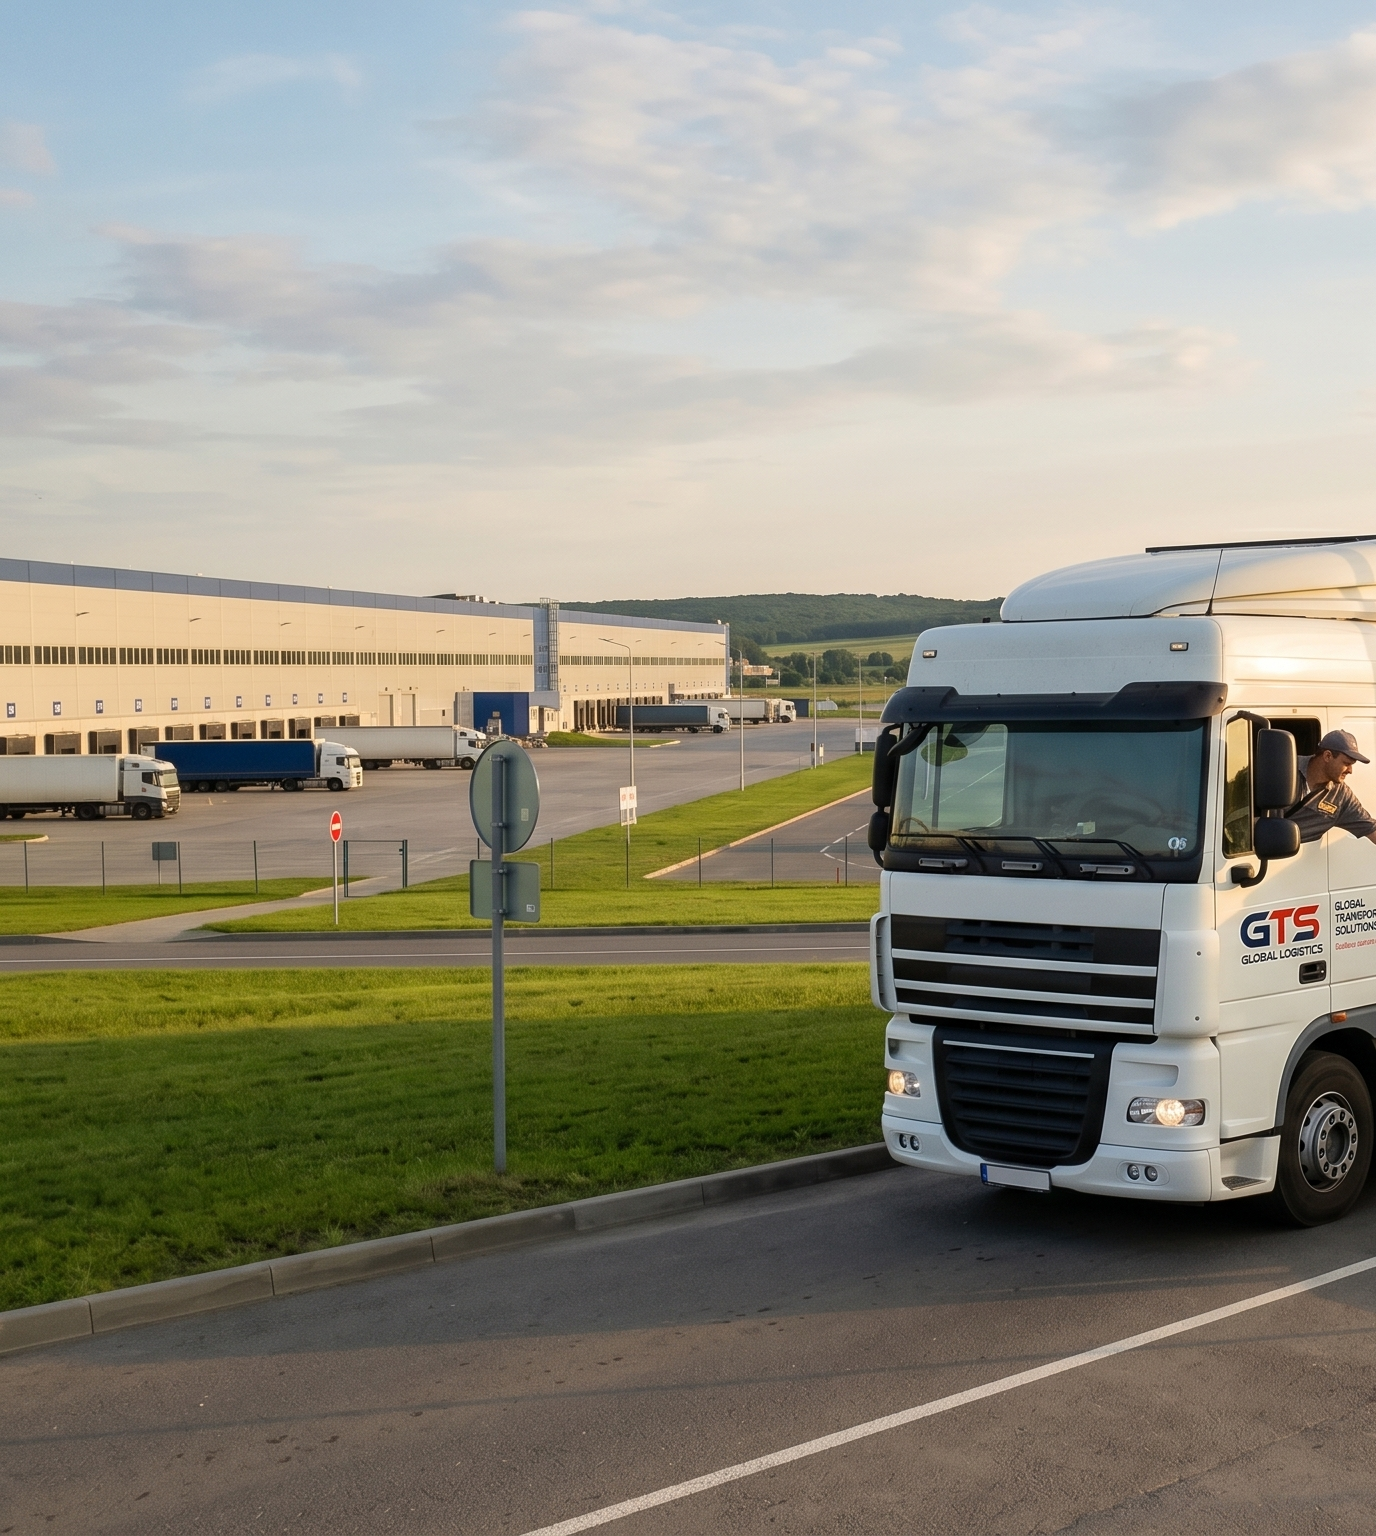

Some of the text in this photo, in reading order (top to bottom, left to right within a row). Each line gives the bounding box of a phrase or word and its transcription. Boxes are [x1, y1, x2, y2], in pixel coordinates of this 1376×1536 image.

[1241, 905, 1320, 948] GTS
[1242, 952, 1278, 965] GLOBAL
[1279, 943, 1323, 959] LOGISTICS
